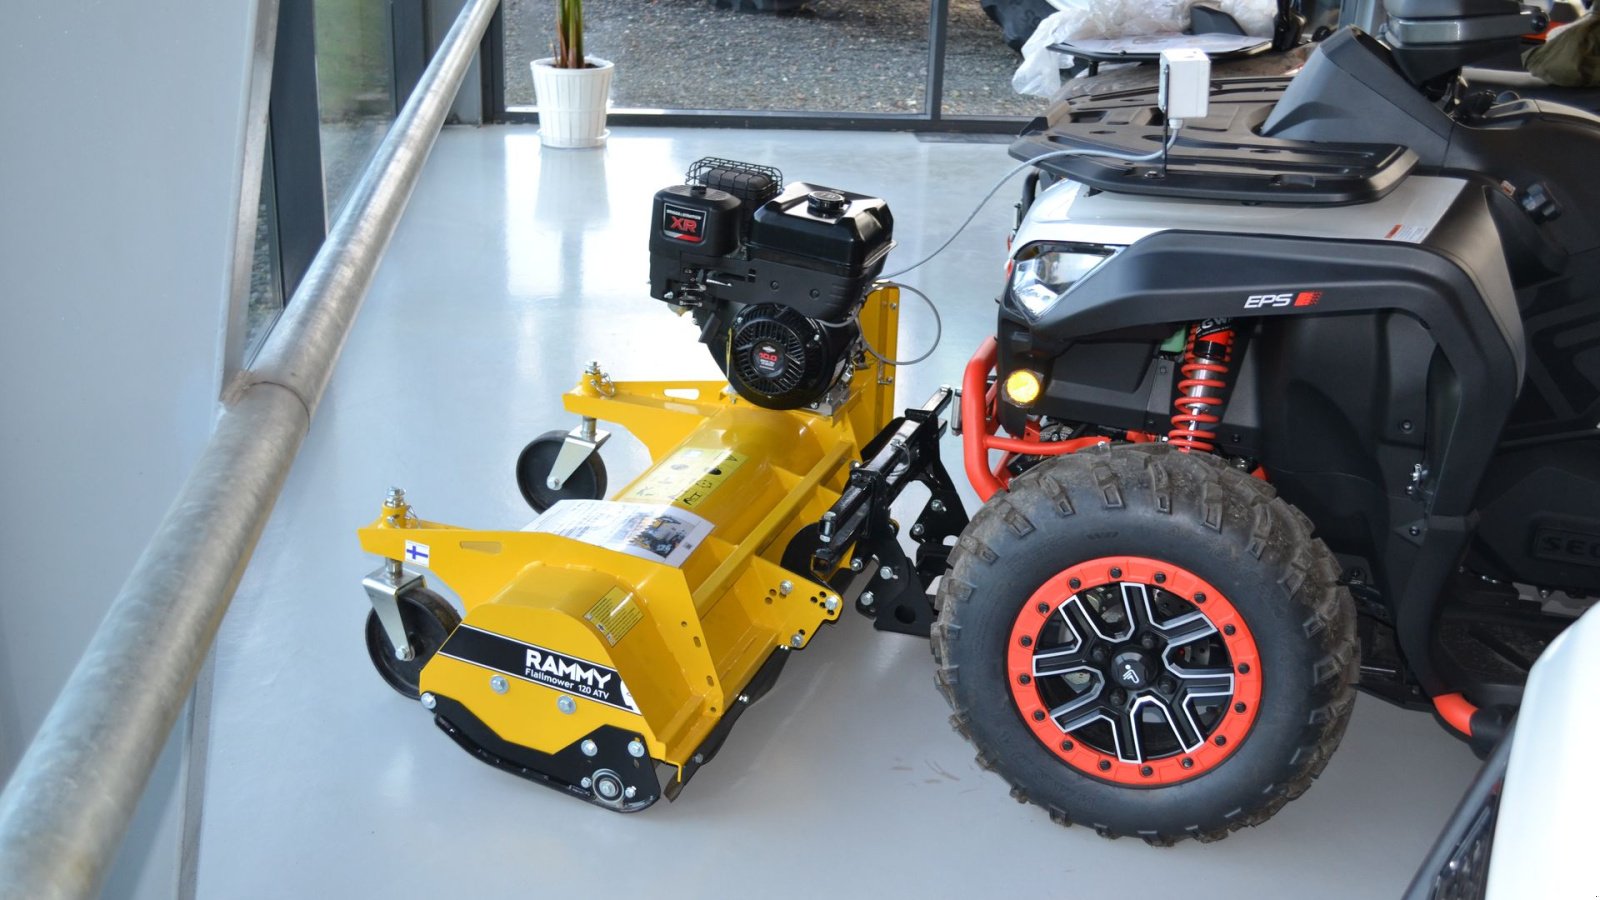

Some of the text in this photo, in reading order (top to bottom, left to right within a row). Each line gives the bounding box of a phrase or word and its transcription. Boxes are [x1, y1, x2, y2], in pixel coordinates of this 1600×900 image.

[671, 216, 697, 233] XR
[1243, 293, 1293, 309] EPS
[526, 648, 612, 689] RAMMY
[525, 668, 609, 700] Flailmower 120 ATV
